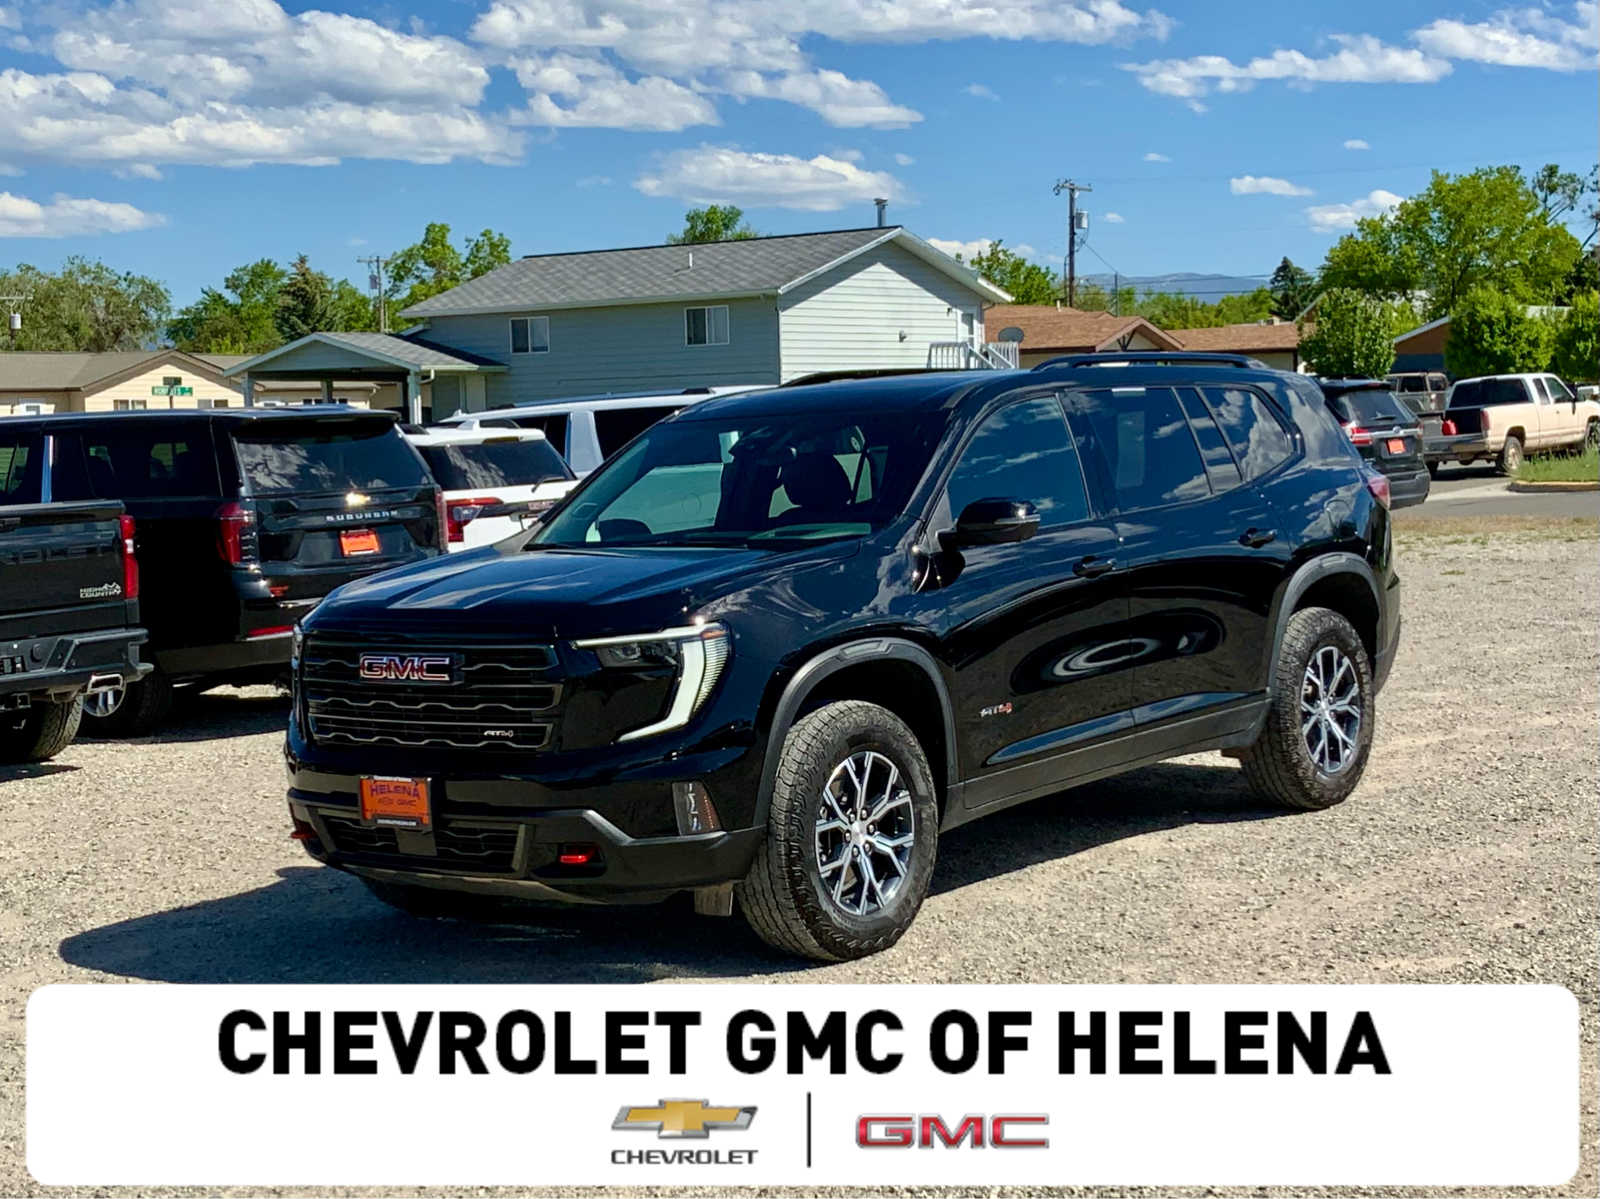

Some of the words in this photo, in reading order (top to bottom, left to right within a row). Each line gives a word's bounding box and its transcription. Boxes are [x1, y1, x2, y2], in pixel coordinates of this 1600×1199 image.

[325, 510, 398, 521] SUBURBAN
[360, 655, 450, 681] GMC
[369, 783, 421, 799] HELENA
